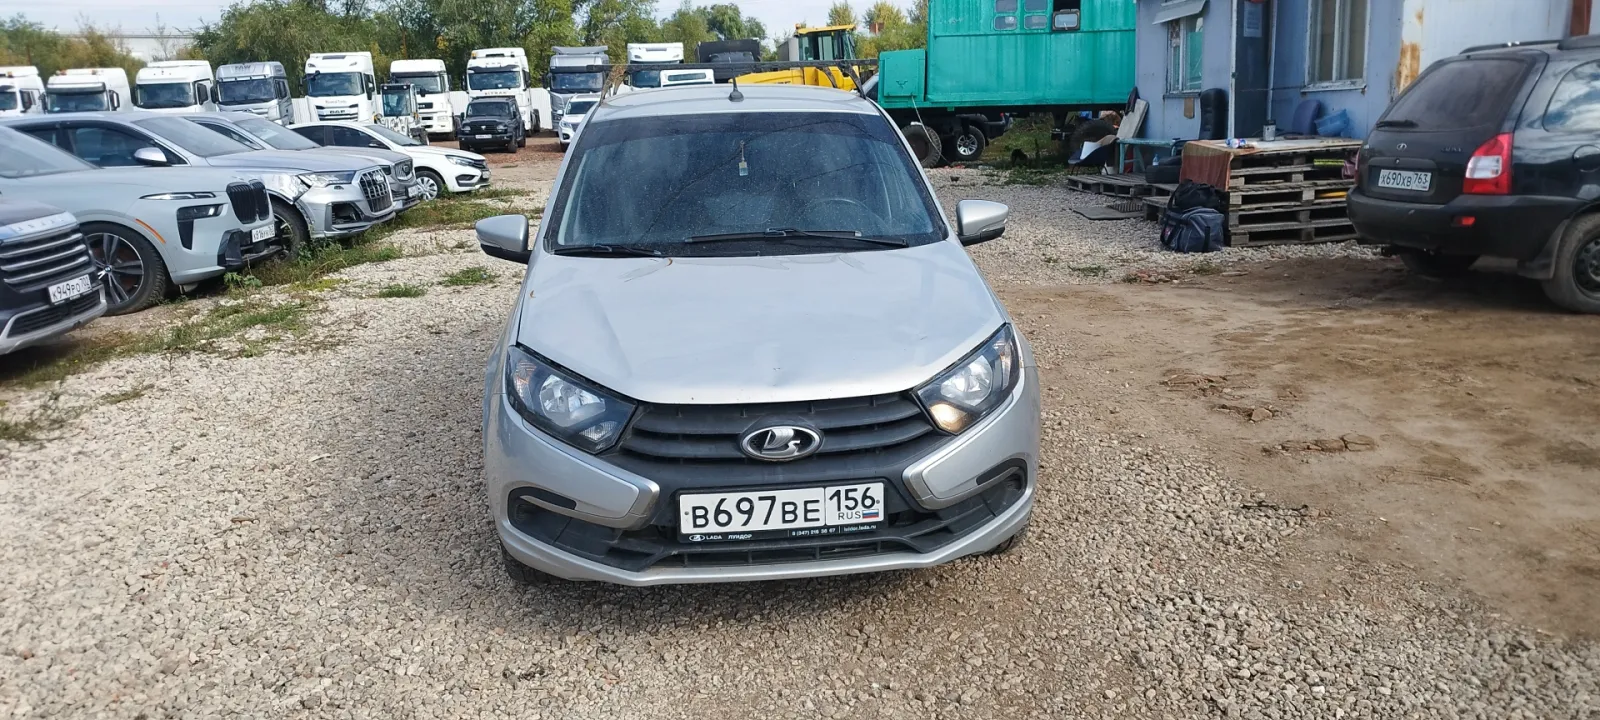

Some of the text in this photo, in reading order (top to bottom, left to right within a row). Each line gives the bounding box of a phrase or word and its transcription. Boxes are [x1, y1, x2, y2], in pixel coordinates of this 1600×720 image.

[1380, 171, 1428, 187] Х690ХВ 763
[51, 283, 81, 301] К949РО
[691, 487, 876, 529] В697ВЕ 156
[838, 511, 862, 521] RUS
